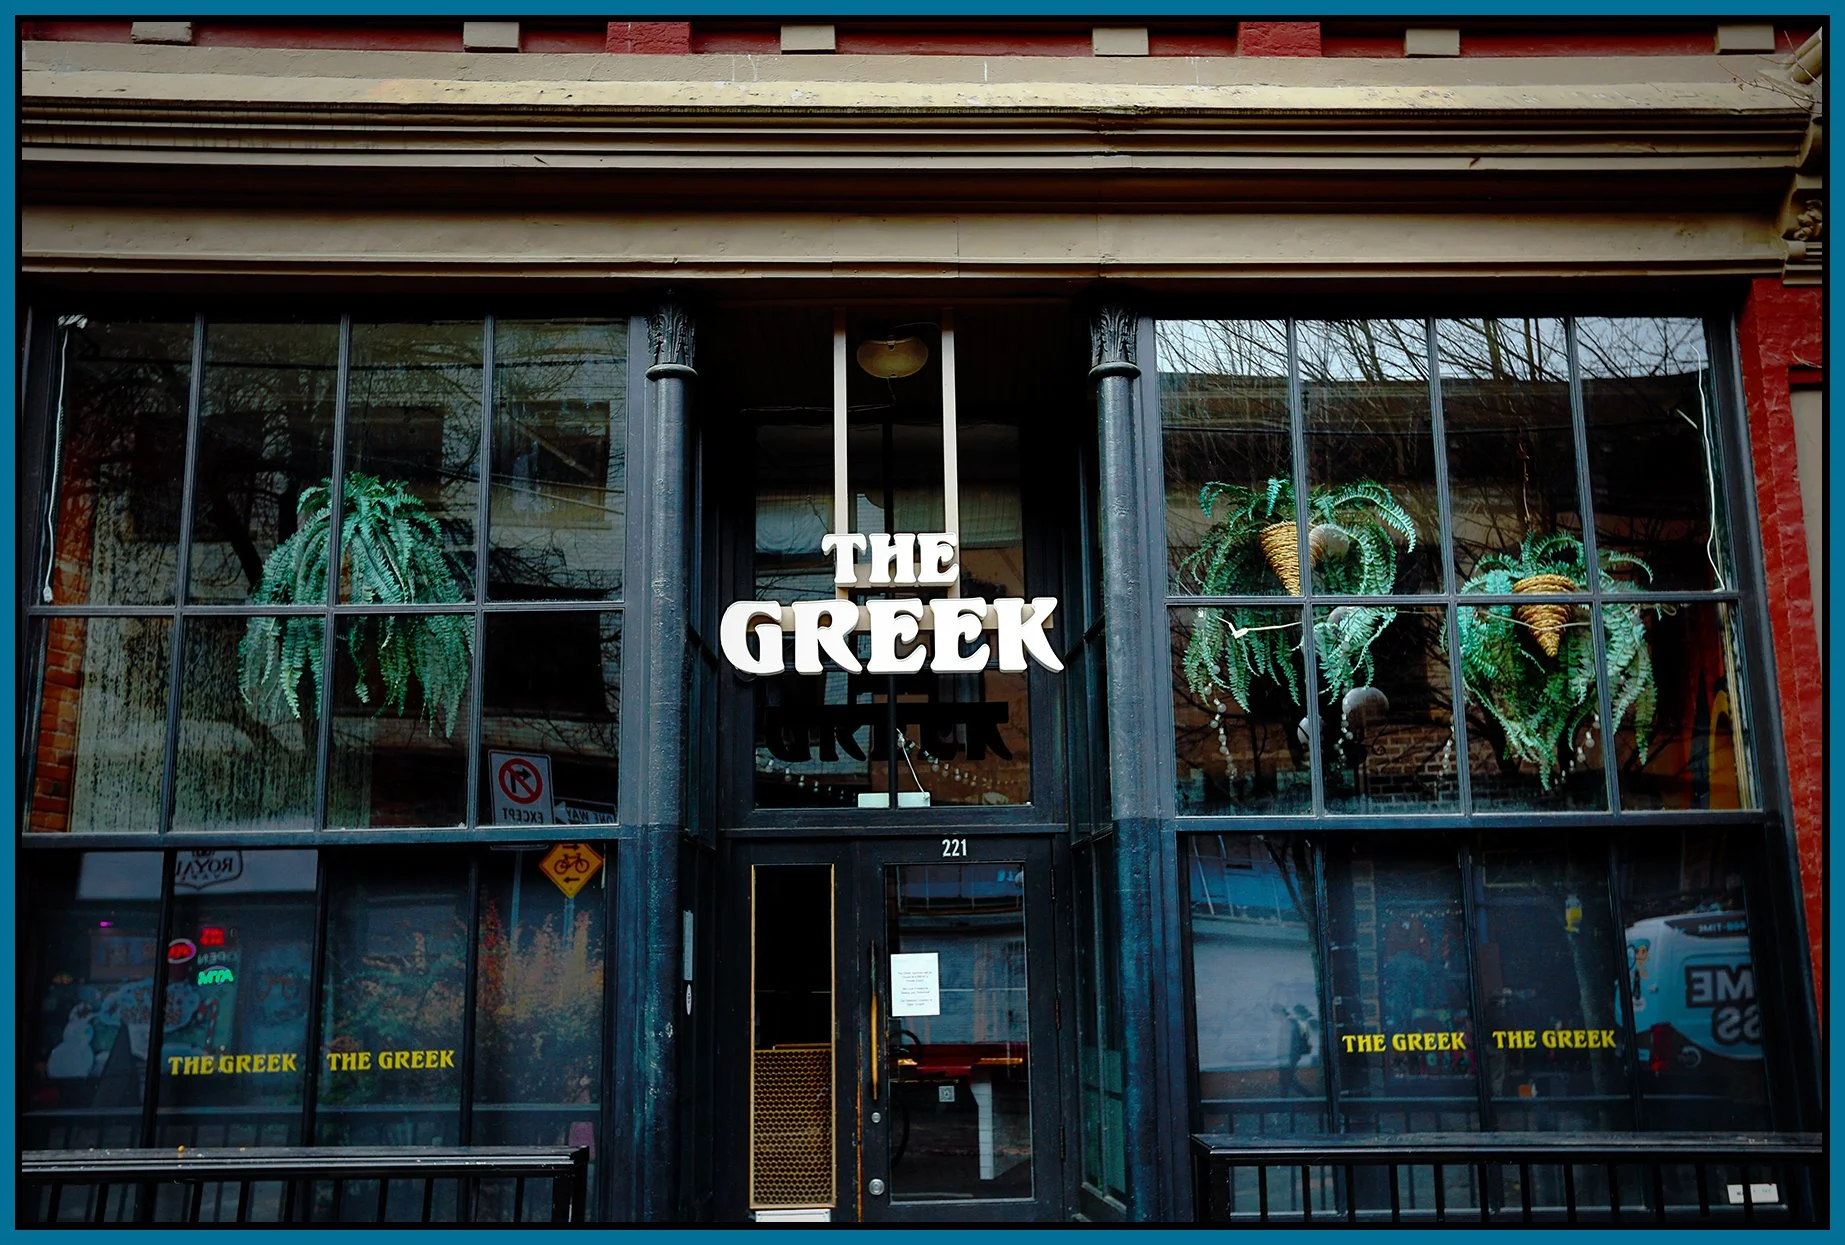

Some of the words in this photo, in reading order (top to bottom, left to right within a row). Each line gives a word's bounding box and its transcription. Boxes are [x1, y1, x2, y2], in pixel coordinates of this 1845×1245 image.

[821, 532, 960, 588] THE
[720, 596, 1065, 677] GREEK
[942, 838, 968, 857] 221
[1343, 1034, 1387, 1053] THE
[1391, 1032, 1467, 1052] GREEK
[1493, 1030, 1537, 1049] THE
[1542, 1030, 1617, 1048] GREEK
[169, 1056, 214, 1075] THE
[218, 1054, 297, 1074] GREEK
[327, 1052, 371, 1071] THE
[378, 1050, 455, 1070] GREEK
